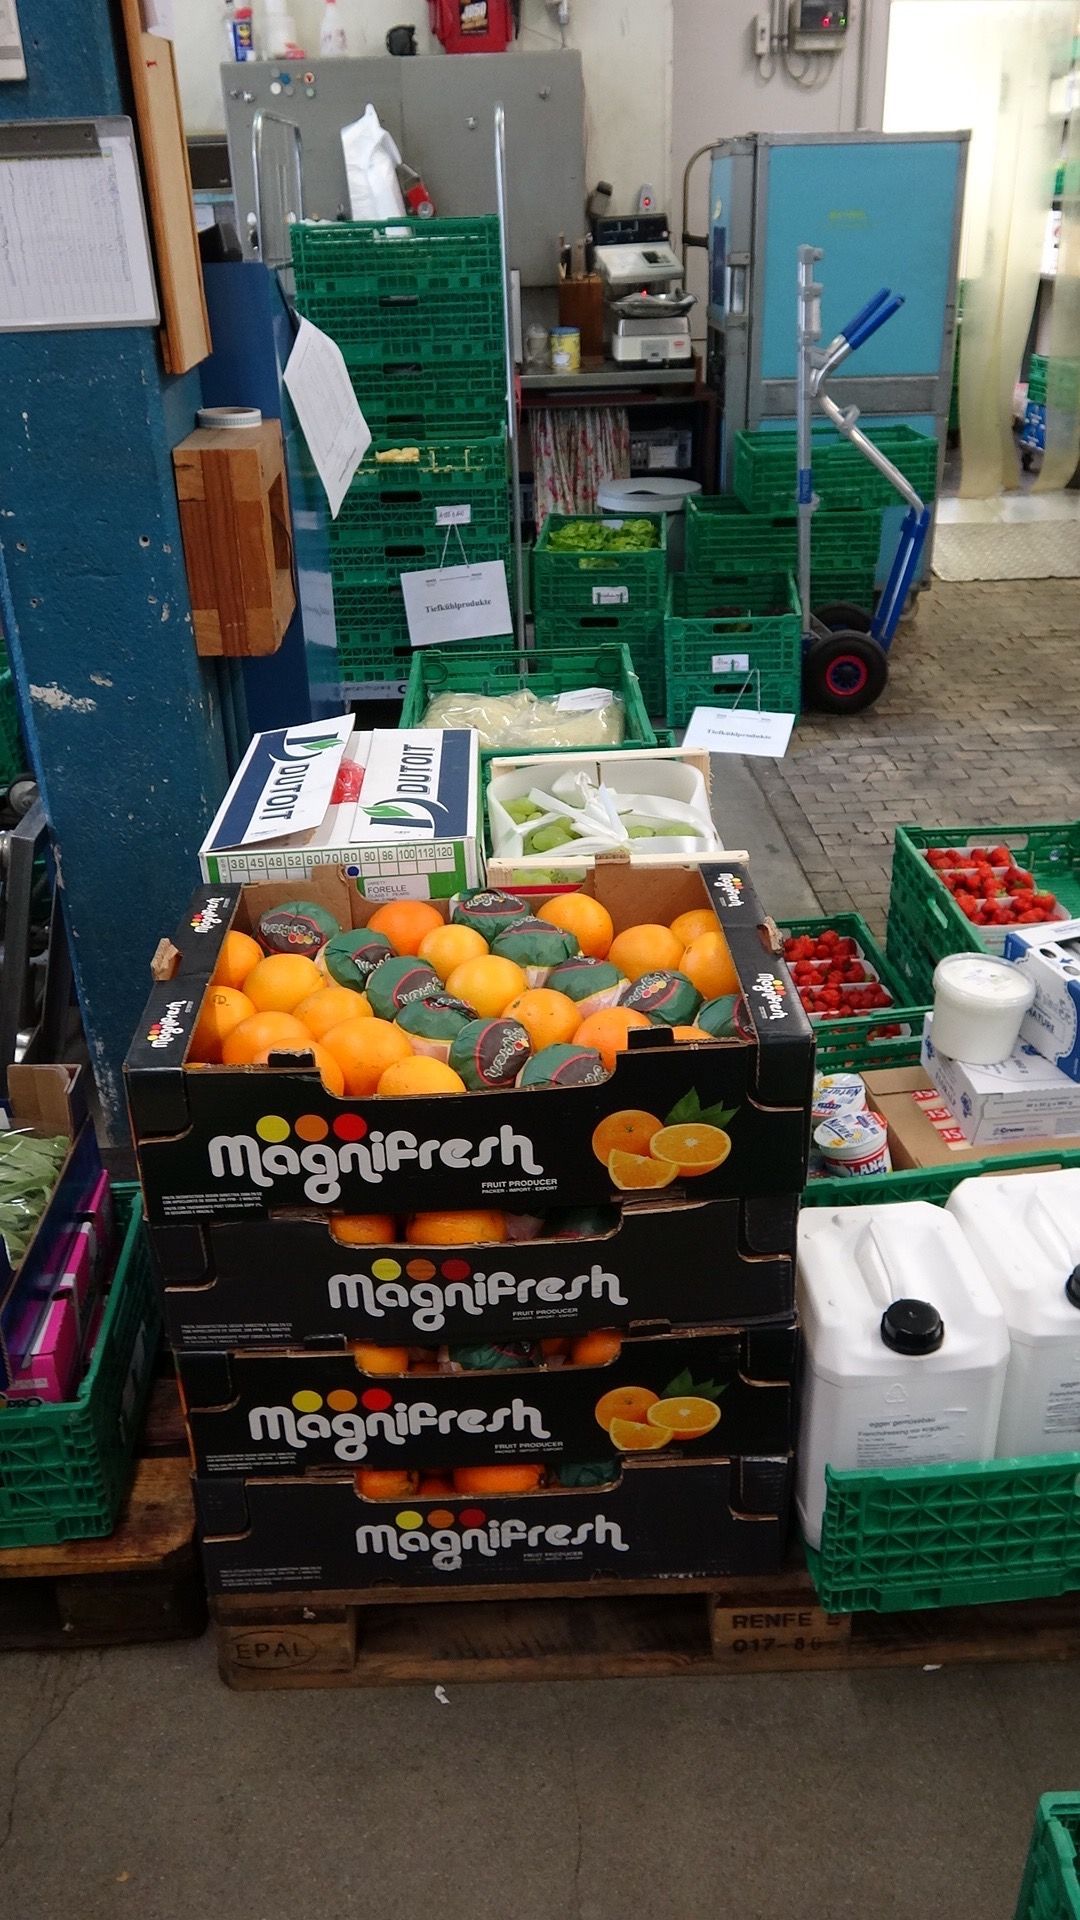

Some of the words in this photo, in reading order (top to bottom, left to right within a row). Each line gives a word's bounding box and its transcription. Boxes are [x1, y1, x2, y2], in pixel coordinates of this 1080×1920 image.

[425, 599, 491, 613] Tiefkühlprodukte
[397, 744, 435, 795] DUTOIT
[259, 764, 310, 820] DUTOIT
[231, 858, 245, 868] 38
[250, 857, 264, 868] 45
[268, 856, 283, 867] 48
[288, 856, 301, 866] 52
[306, 854, 321, 864] 60
[325, 854, 339, 864] 70
[343, 852, 358, 863] 80
[364, 852, 376, 862] 90
[382, 851, 393, 861] 96
[400, 849, 415, 859] 100
[418, 848, 434, 858] 112
[437, 846, 453, 856] 120
[367, 885, 407, 893] FORELLE
[826, 1119, 854, 1139] Nature
[508, 1178, 558, 1186] PRODUCER
[732, 1612, 812, 1629] RENFE
[236, 1642, 313, 1659] EPAL
